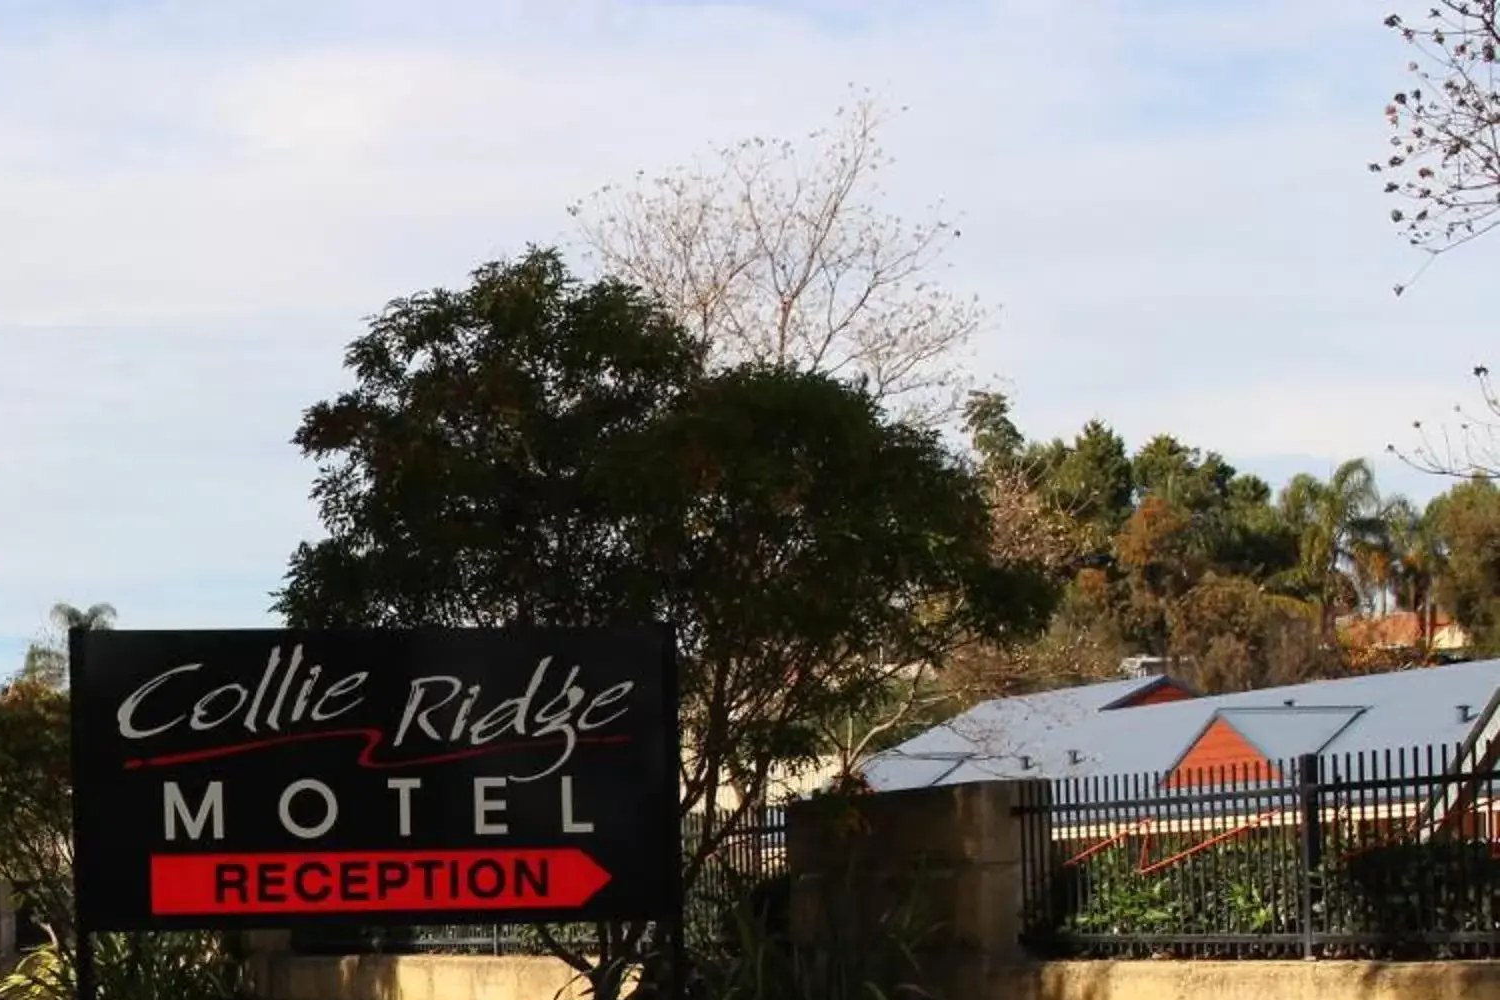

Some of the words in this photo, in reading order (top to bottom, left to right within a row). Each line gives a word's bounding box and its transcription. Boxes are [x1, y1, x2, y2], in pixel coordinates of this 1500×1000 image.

[117, 643, 370, 738] Collie
[394, 656, 634, 781] Ridge
[163, 775, 594, 841] MOTEL
[214, 858, 550, 904] RECEPTION
